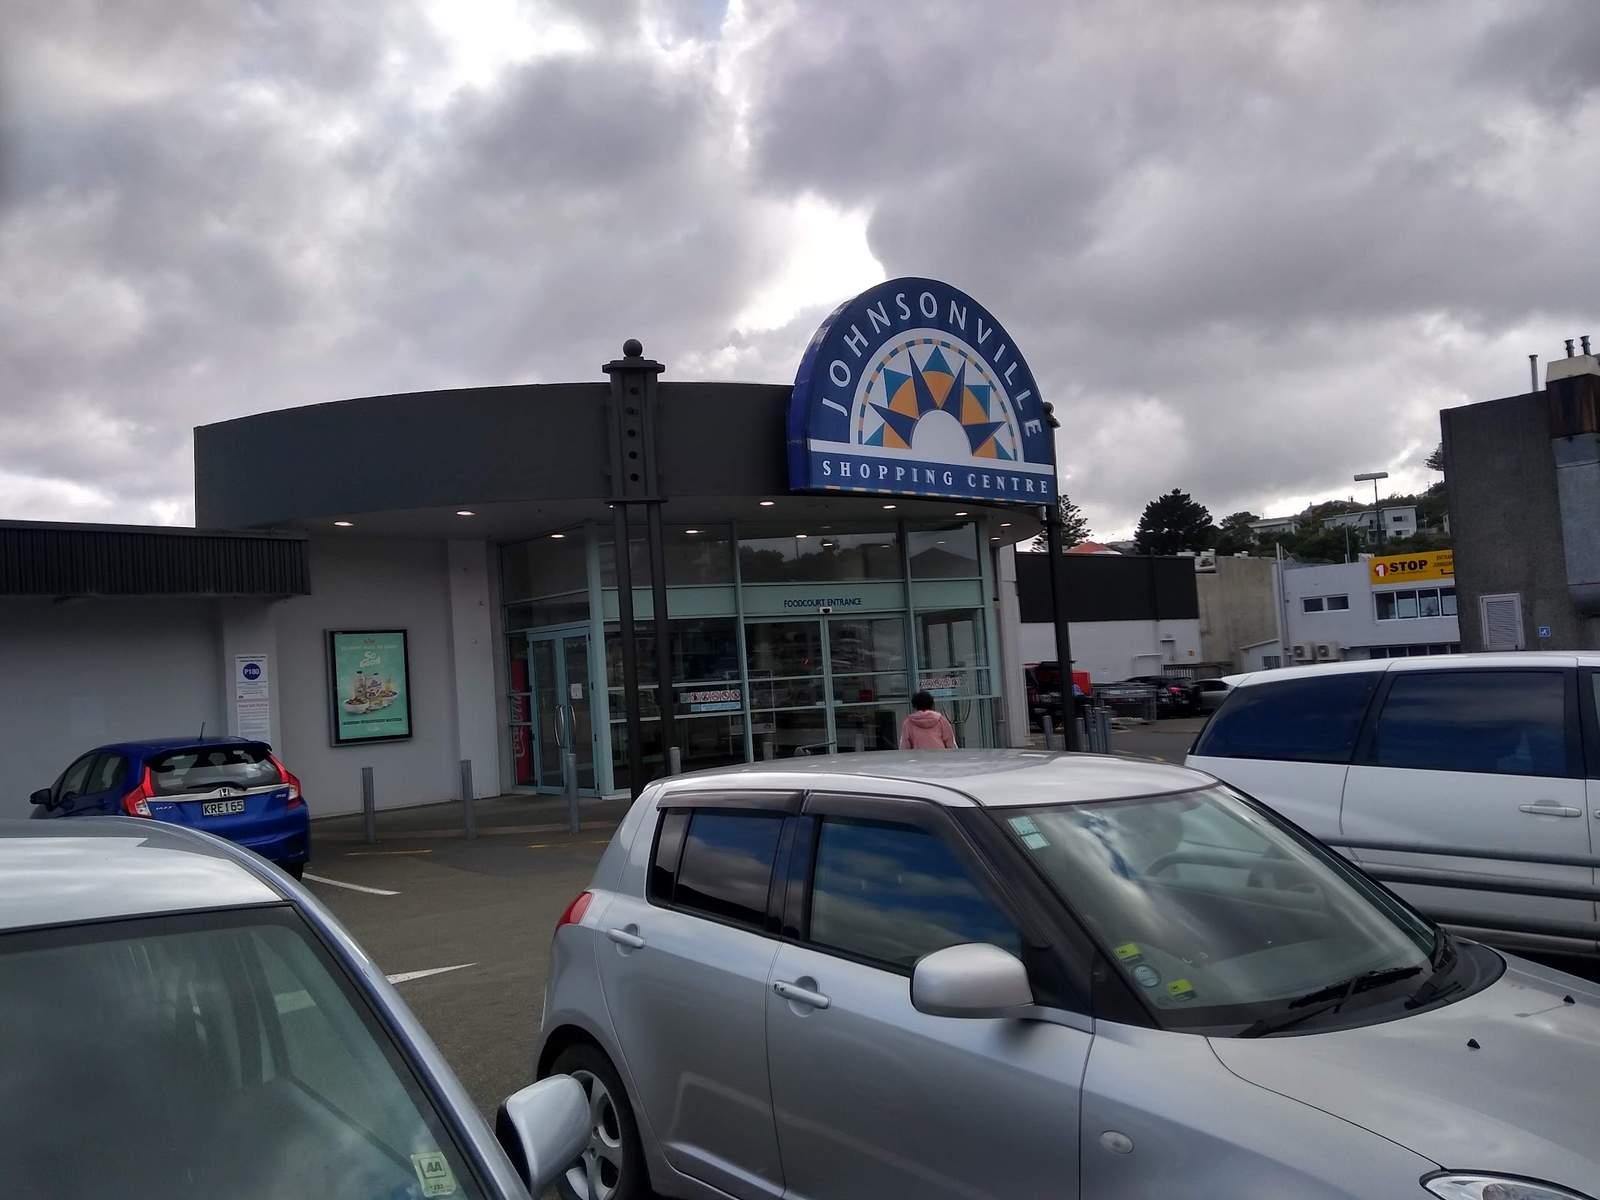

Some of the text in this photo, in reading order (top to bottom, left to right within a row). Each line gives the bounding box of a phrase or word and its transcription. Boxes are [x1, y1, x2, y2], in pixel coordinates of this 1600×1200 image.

[822, 291, 1043, 437] JOHNSONVILLE
[823, 460, 1048, 494] SHOPPING CENTRE
[1389, 559, 1428, 573] STOP
[784, 597, 862, 608] FOODCOURT ENTRANCE
[203, 800, 243, 815] KRE165
[426, 1161, 442, 1172] AA
